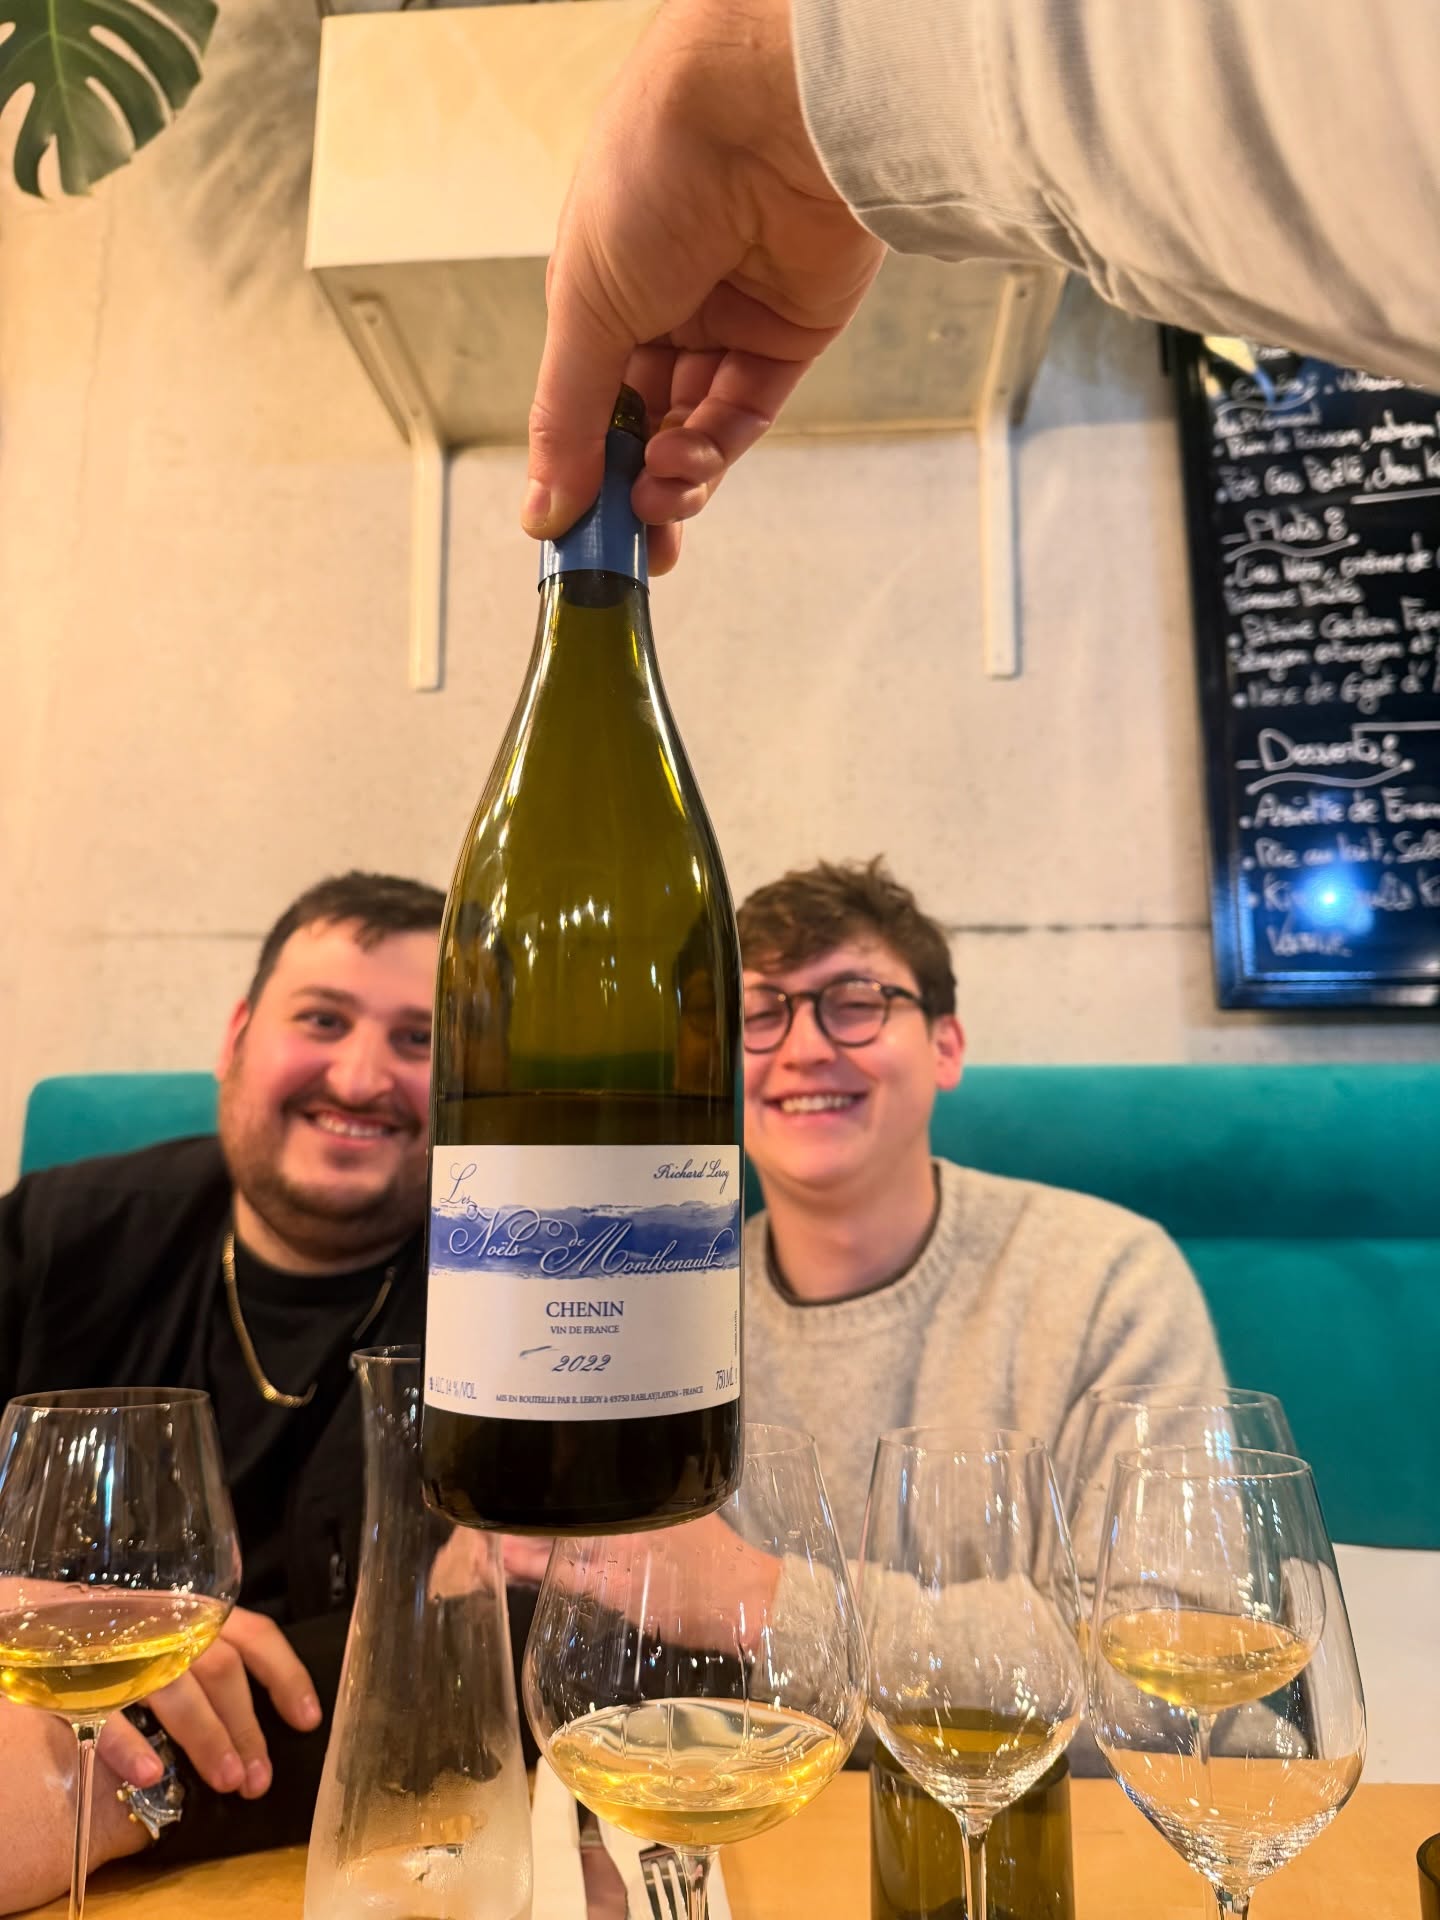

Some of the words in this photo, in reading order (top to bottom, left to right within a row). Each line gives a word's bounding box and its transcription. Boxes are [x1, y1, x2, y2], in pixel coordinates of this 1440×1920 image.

[440, 1162, 477, 1205] Les
[653, 1158, 708, 1179] Richard
[706, 1158, 730, 1195] Leroy
[546, 1301, 624, 1318] CHENIN
[550, 1325, 567, 1334] VIN
[569, 1325, 582, 1334] DE
[583, 1325, 620, 1334] FRANCE
[551, 1354, 612, 1373] 2022
